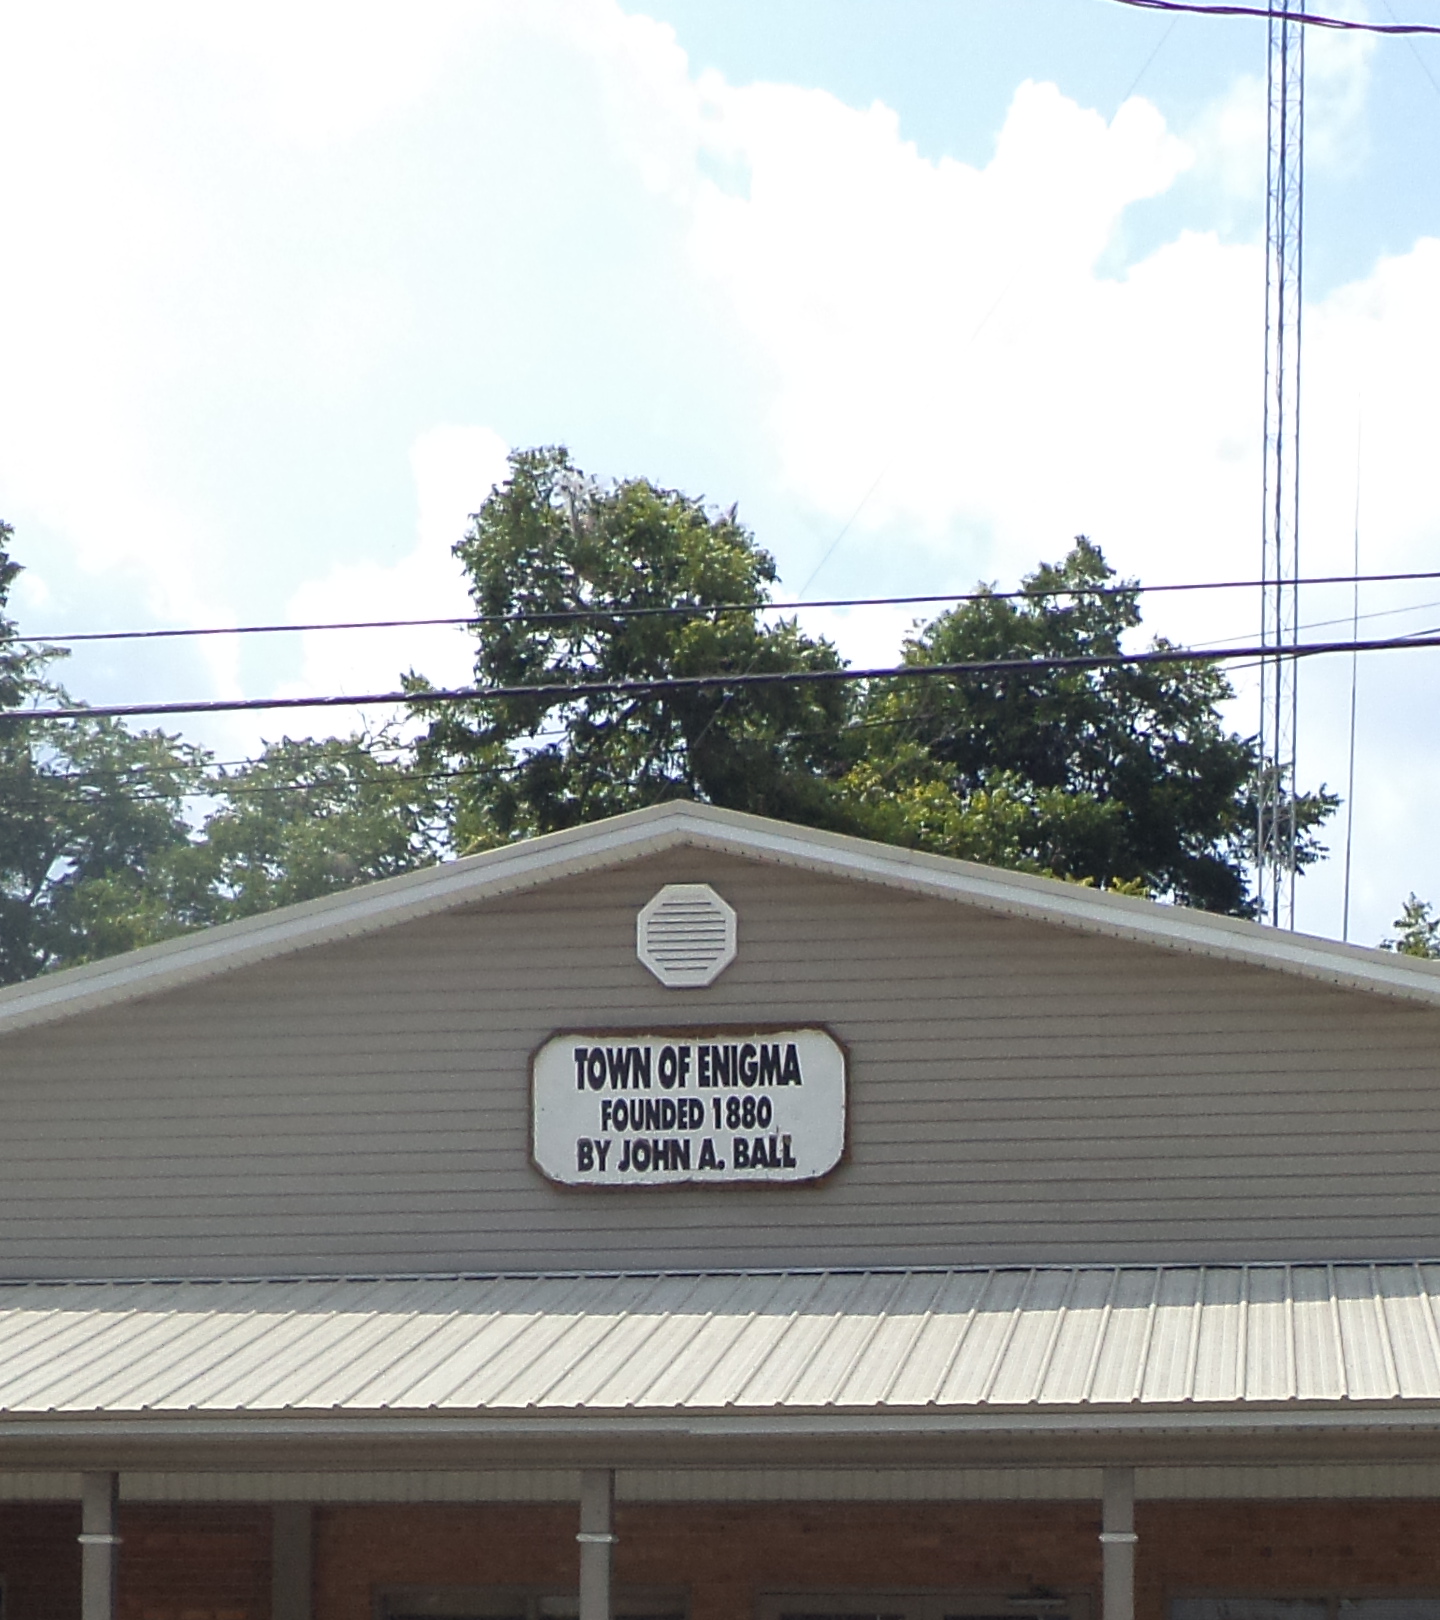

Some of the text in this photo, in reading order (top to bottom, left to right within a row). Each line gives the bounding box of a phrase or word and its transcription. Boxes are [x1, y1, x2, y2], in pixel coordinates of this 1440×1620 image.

[574, 1043, 803, 1090] TOWN OF ENIGMA
[601, 1095, 773, 1131] FOUNDED 1880
[576, 1134, 797, 1172] BY JOHN A. BALL
